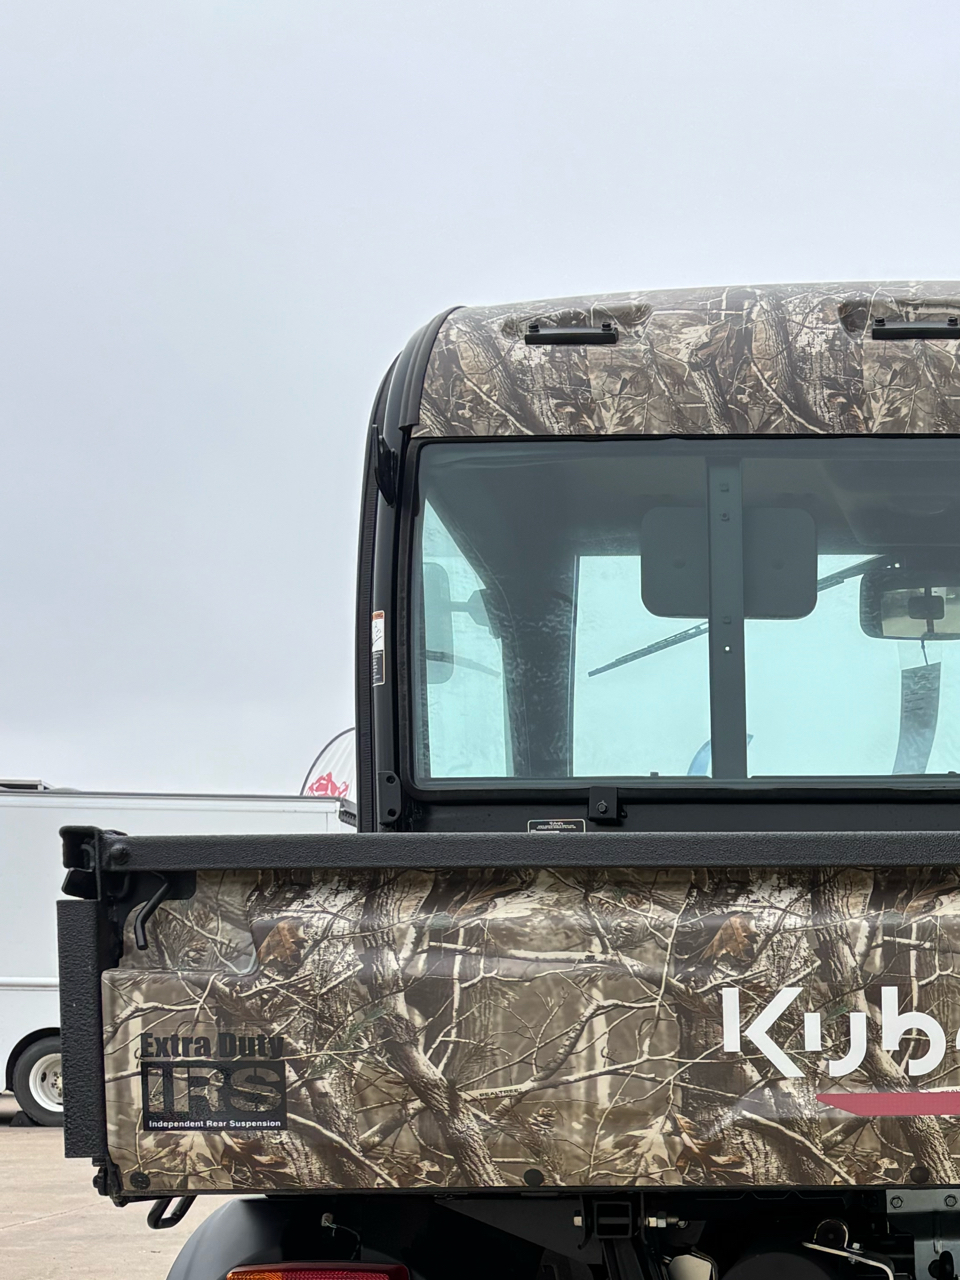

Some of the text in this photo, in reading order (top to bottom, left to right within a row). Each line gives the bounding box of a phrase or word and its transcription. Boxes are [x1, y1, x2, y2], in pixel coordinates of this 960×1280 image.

[141, 1033, 284, 1059] Extra Duty
[148, 1067, 282, 1112] IRS
[149, 1120, 203, 1128] Independent
[230, 1120, 281, 1128] Suspension
